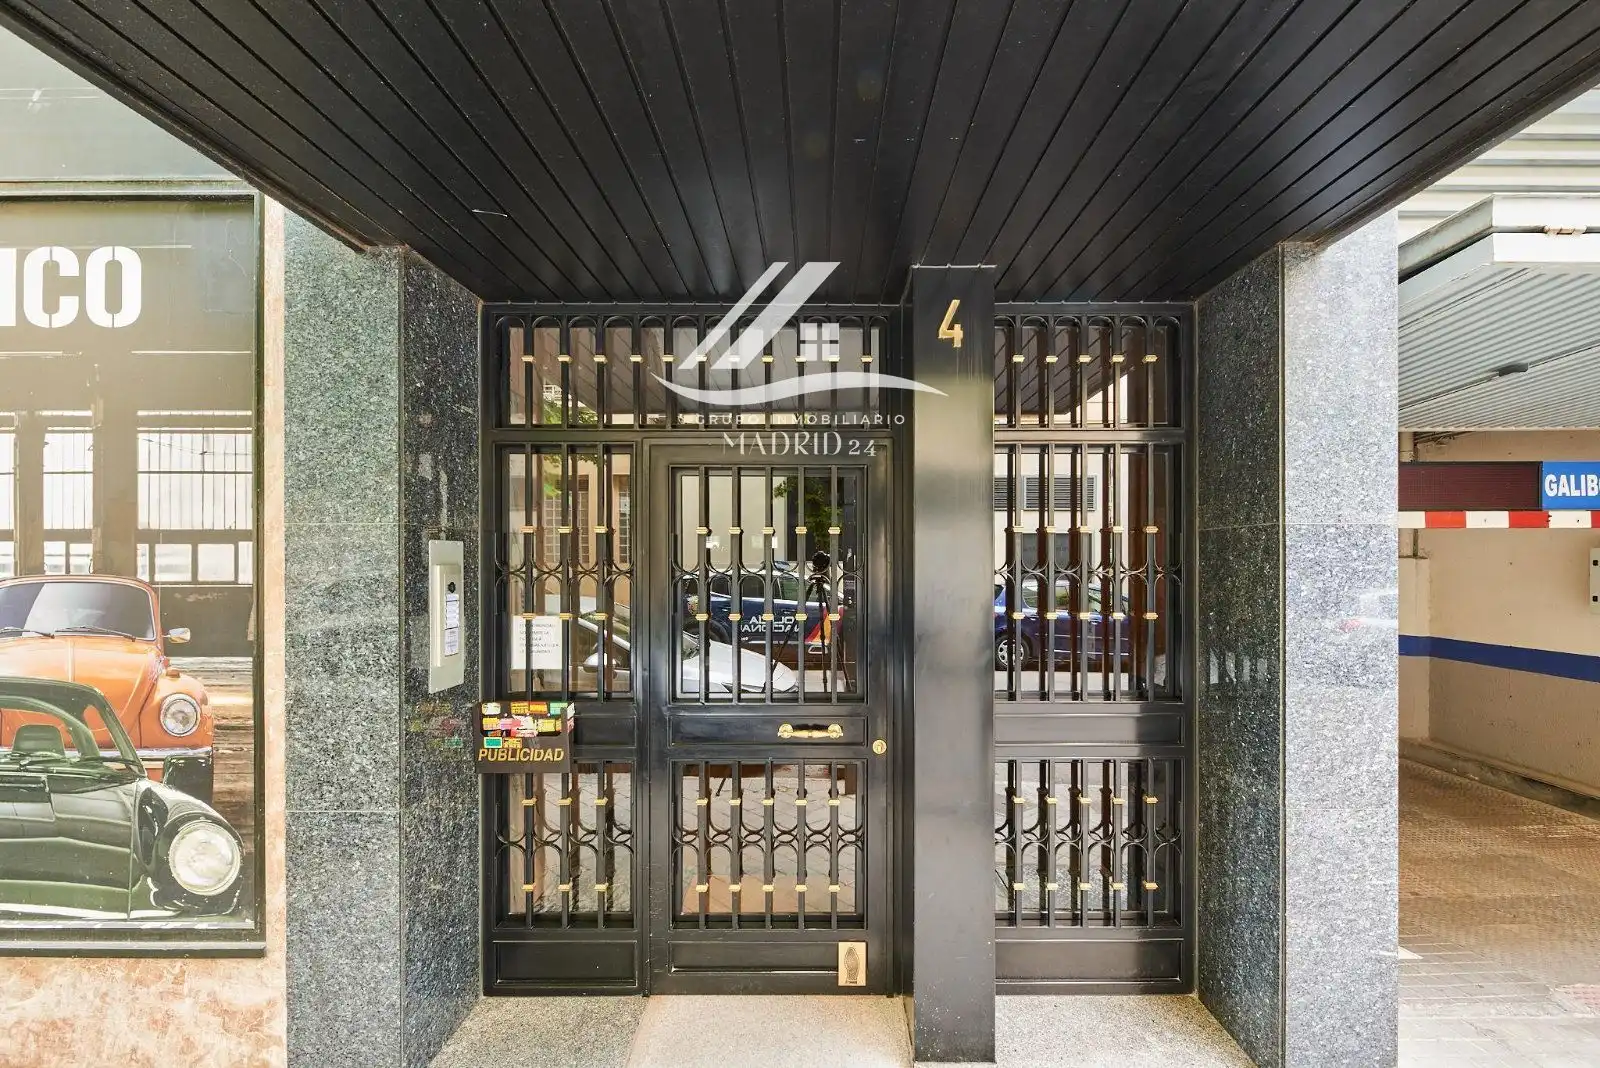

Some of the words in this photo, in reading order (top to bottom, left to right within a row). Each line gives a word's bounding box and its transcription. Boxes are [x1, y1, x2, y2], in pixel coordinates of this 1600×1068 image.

[938, 299, 963, 348] 4
[1545, 474, 1600, 497] GALIB
[478, 747, 565, 762] PUBLICIDAD
